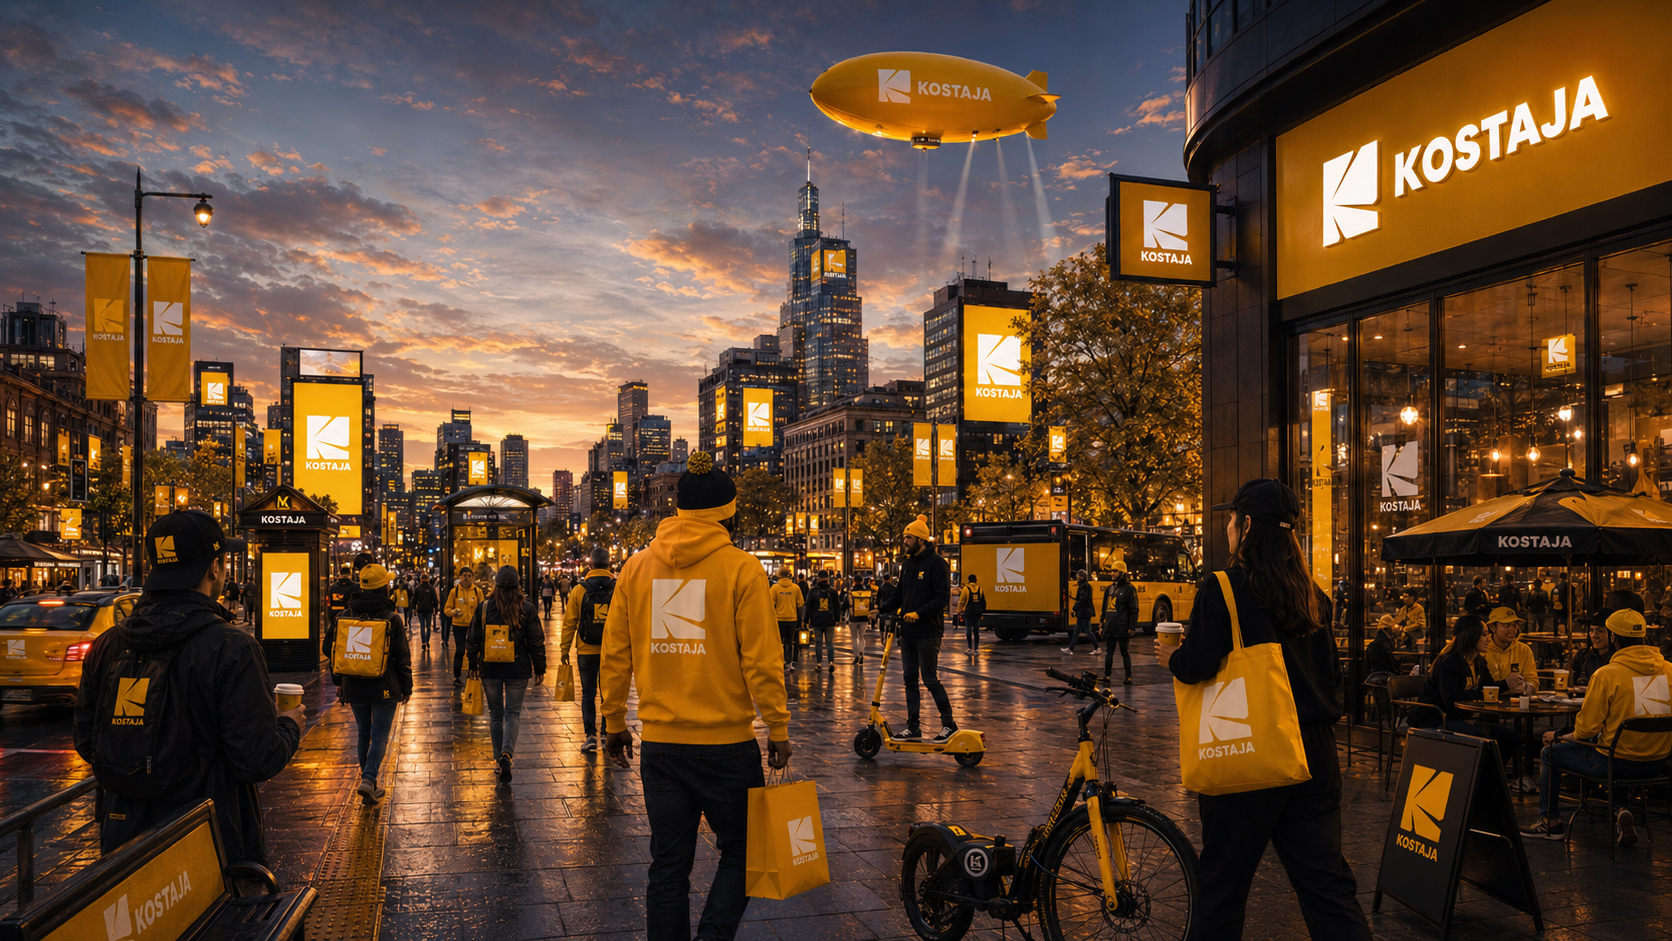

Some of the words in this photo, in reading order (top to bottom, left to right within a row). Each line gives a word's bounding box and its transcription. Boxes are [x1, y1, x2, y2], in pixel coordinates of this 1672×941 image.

[917, 80, 992, 102] KOSTAJA
[1394, 75, 1611, 198] KOSTAJA
[1140, 250, 1193, 266] KOSTAJA
[975, 387, 1023, 399] KOSTAJA
[305, 461, 351, 471] KOSTAJA
[1380, 500, 1421, 512] KOSTAJA
[261, 515, 306, 525] KOSTAJA
[1497, 535, 1572, 549] KOSTAJA
[994, 585, 1027, 593] KOSTAJA
[269, 610, 303, 618] KOSTAJA
[650, 642, 707, 655] KOSTAJA
[111, 717, 145, 726] KOSTAJA
[1198, 741, 1255, 760] KOSTAJA
[1396, 833, 1438, 862] KOSTAJA
[133, 870, 192, 935] KOSTAJA
